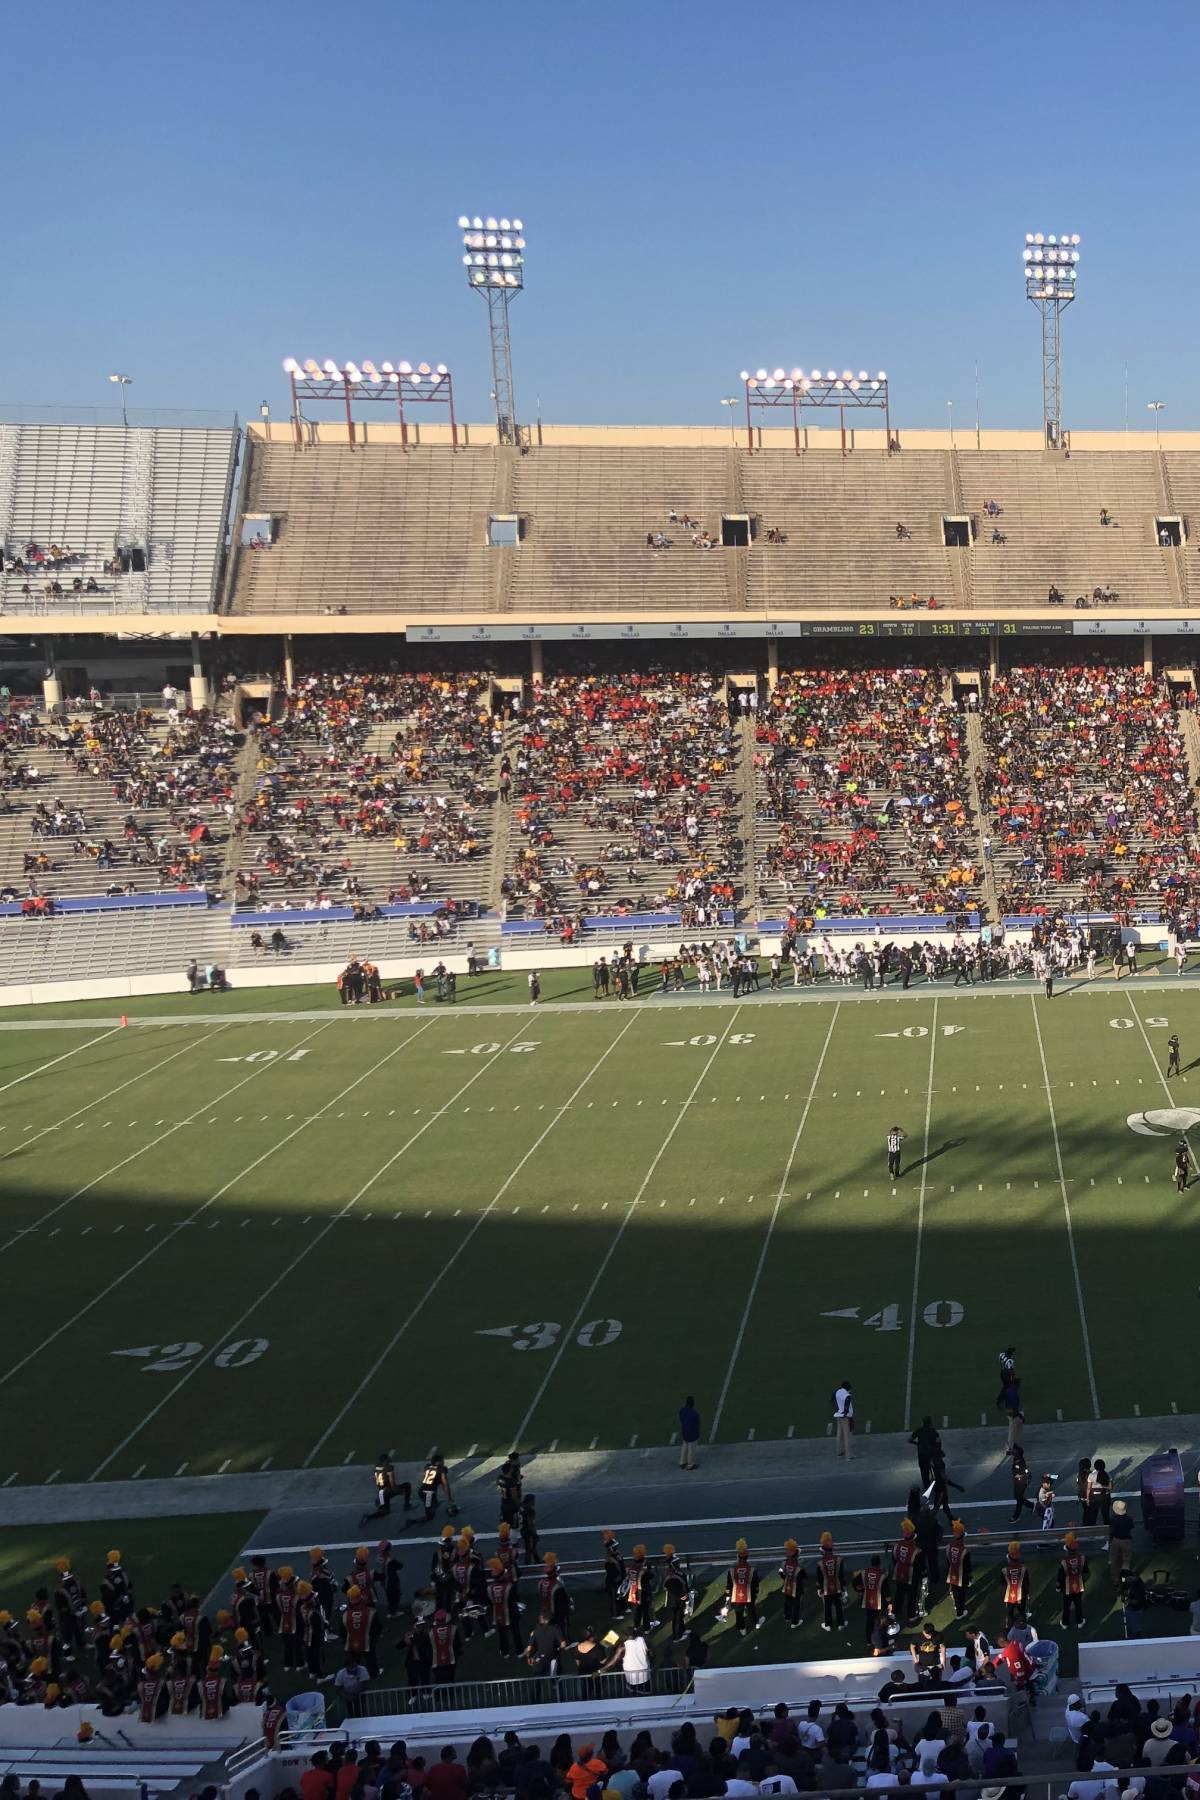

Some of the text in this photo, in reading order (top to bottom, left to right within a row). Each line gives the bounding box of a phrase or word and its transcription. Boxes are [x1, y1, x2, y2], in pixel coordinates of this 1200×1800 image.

[859, 624, 875, 635] 23
[932, 624, 955, 635] 1:31
[980, 627, 990, 635] 31
[1003, 623, 1016, 634] 31
[1109, 1017, 1168, 1029] 50
[903, 1025, 966, 1038] 40
[689, 1033, 756, 1046] 30
[471, 1042, 543, 1054] 20
[245, 1050, 312, 1062] 10
[863, 1300, 968, 1331] 40
[512, 1318, 623, 1351] 30
[140, 1338, 269, 1372] 20
[422, 1469, 438, 1485] 12
